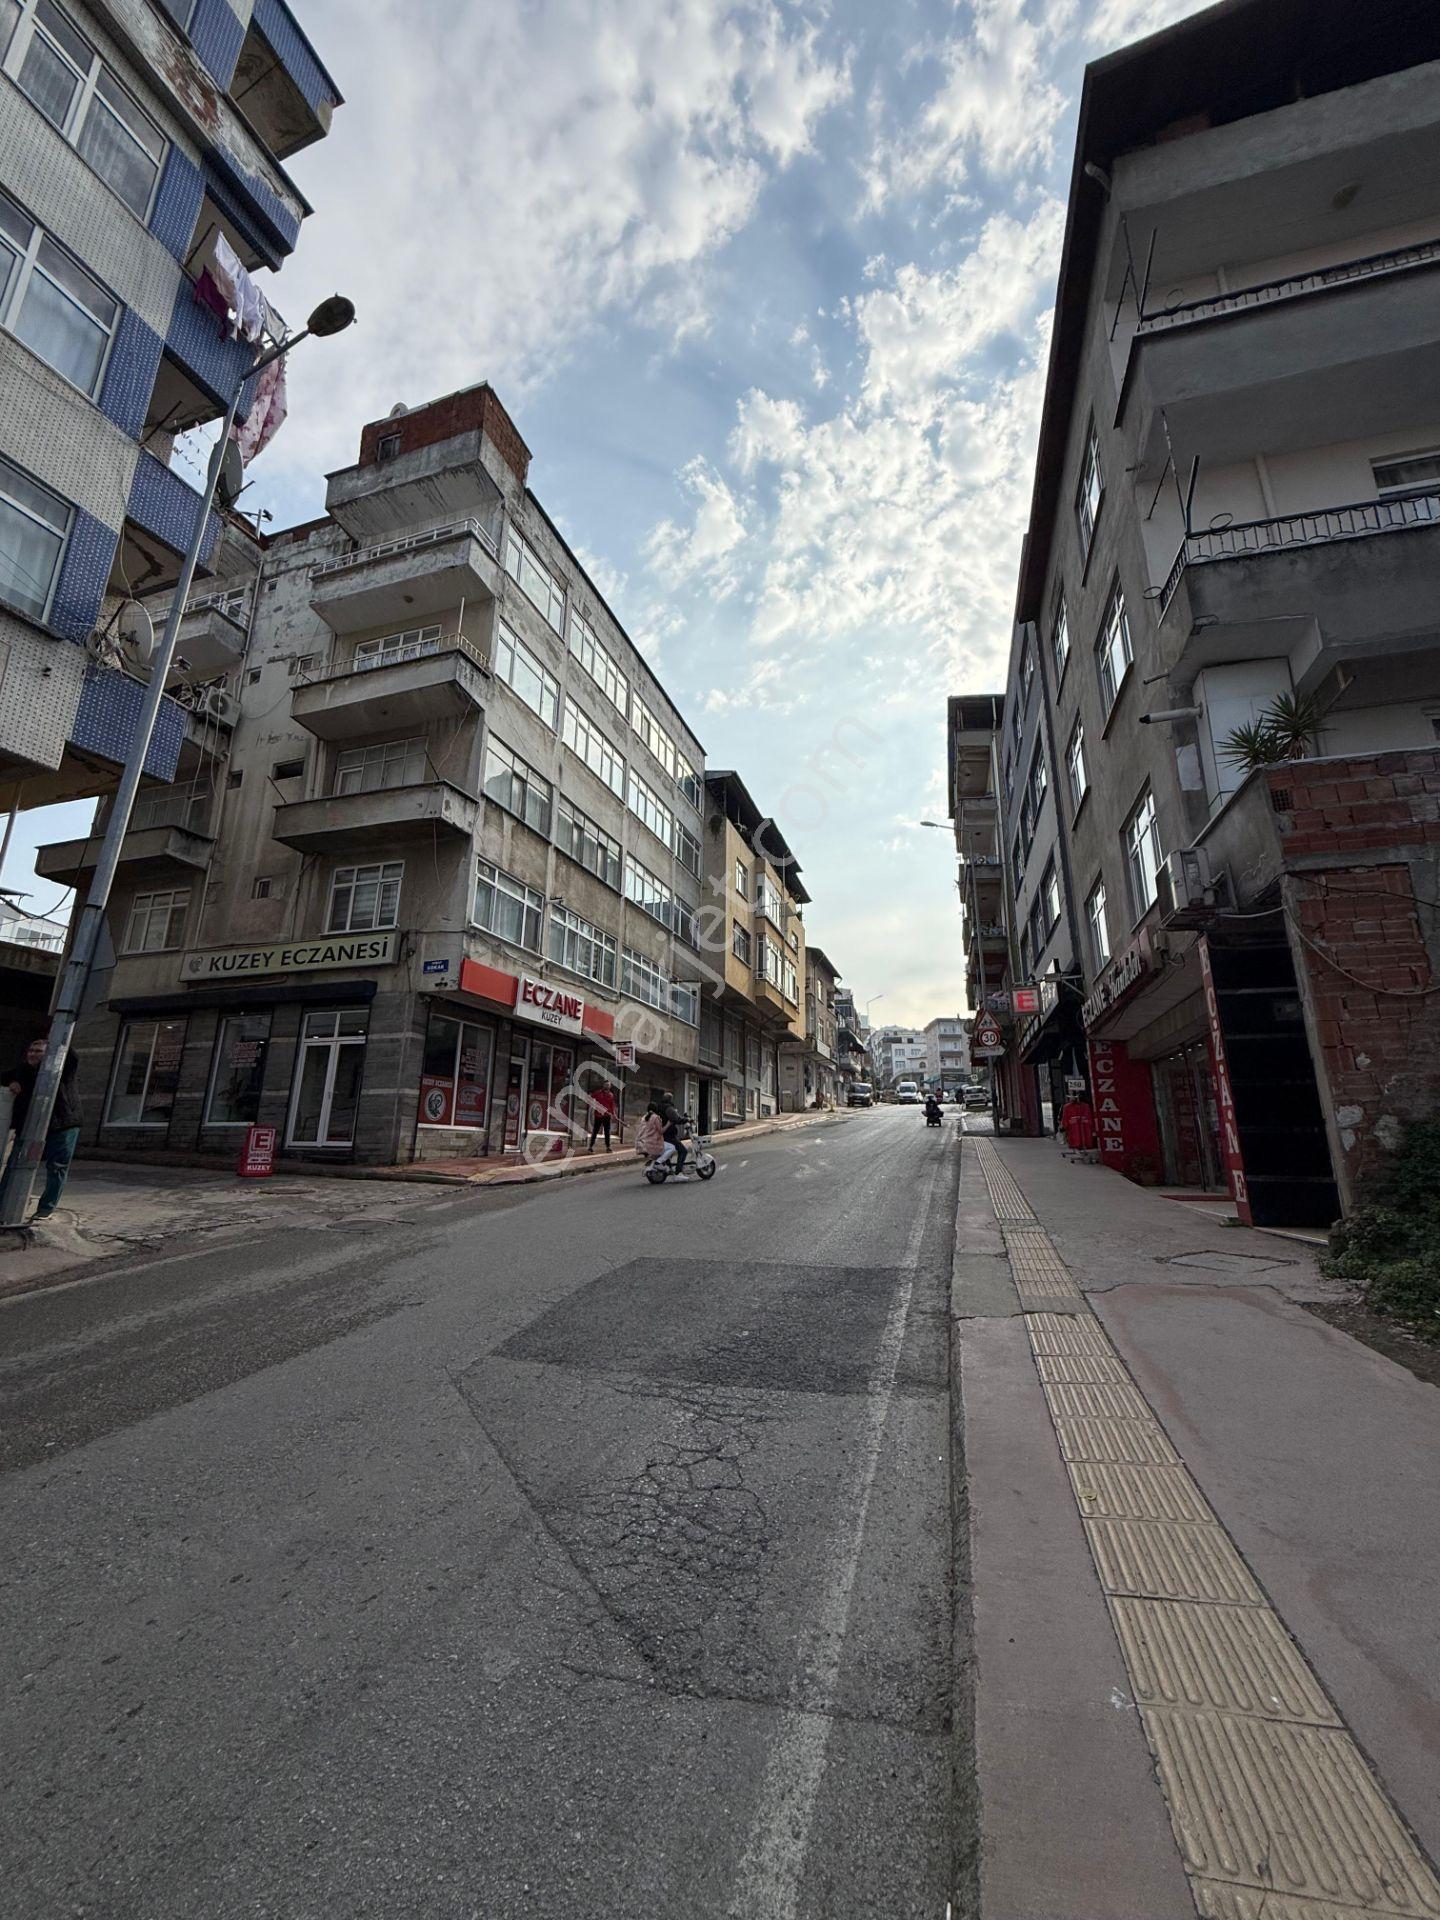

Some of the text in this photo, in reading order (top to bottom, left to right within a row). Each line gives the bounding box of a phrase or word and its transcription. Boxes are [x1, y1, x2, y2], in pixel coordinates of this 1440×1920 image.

[209, 936, 388, 972] KUZEY ECZANESİ
[522, 978, 583, 1019] ECZANE
[1016, 991, 1035, 1009] E
[1081, 983, 1107, 1028] ECZANE
[541, 1010, 562, 1025] KUZEY
[983, 1033, 996, 1042] 30
[1094, 1040, 1124, 1151] ECZANE
